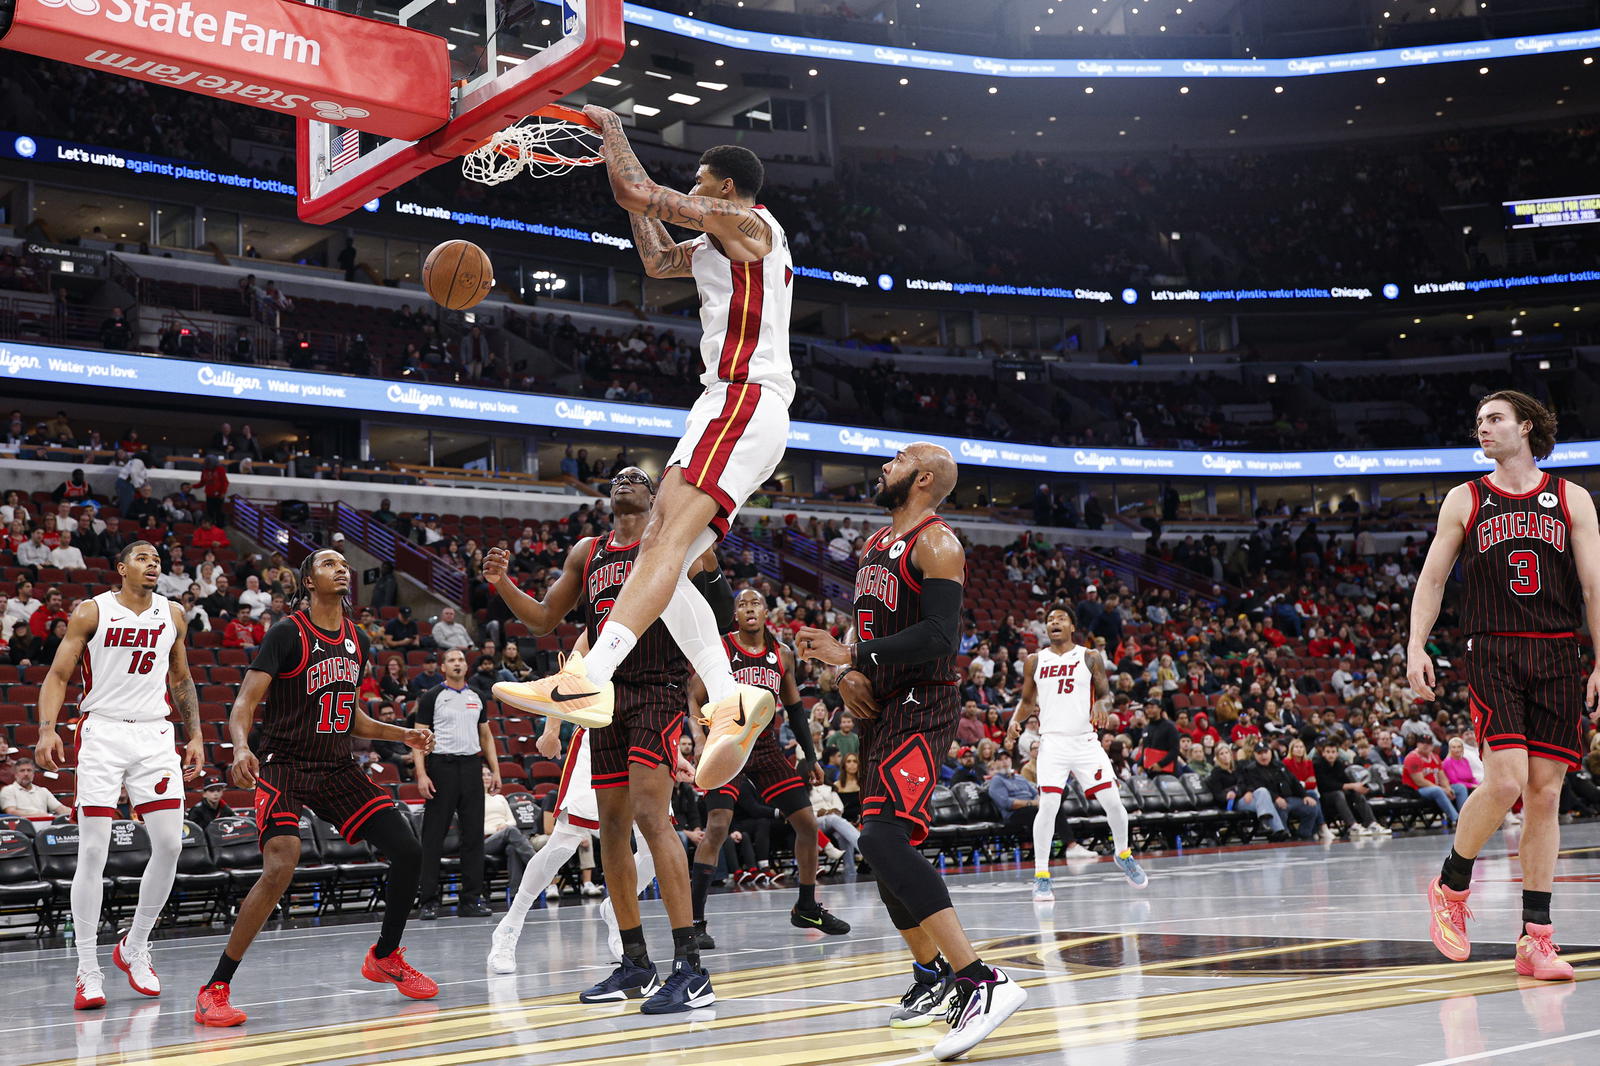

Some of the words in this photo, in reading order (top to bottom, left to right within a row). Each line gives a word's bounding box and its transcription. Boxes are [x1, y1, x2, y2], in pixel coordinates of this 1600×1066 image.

[57, 145, 89, 163] Let's
[90, 152, 125, 168] unite
[126, 158, 174, 177] against
[174, 165, 216, 183] plastic
[217, 171, 251, 188] water
[396, 201, 422, 215] Let's
[423, 205, 450, 219] unite
[451, 211, 490, 225] against
[490, 216, 524, 231] plastic
[525, 223, 553, 236] water
[1569, 270, 1600, 282] bottle
[48, 358, 84, 374] Water
[87, 365, 109, 377] you
[267, 380, 301, 394] Water
[302, 384, 321, 397] you
[449, 397, 477, 409] Water
[478, 402, 496, 413] you
[1477, 512, 1565, 553] CHICAGO
[588, 560, 634, 603] CHICA
[1508, 549, 1541, 595] 3
[595, 598, 616, 637] 2
[858, 609, 875, 642] 5
[104, 622, 166, 648] HEAT
[128, 650, 156, 675] 16
[1039, 660, 1080, 679] HEAT
[1057, 679, 1075, 695] 15
[316, 691, 356, 734] 15
